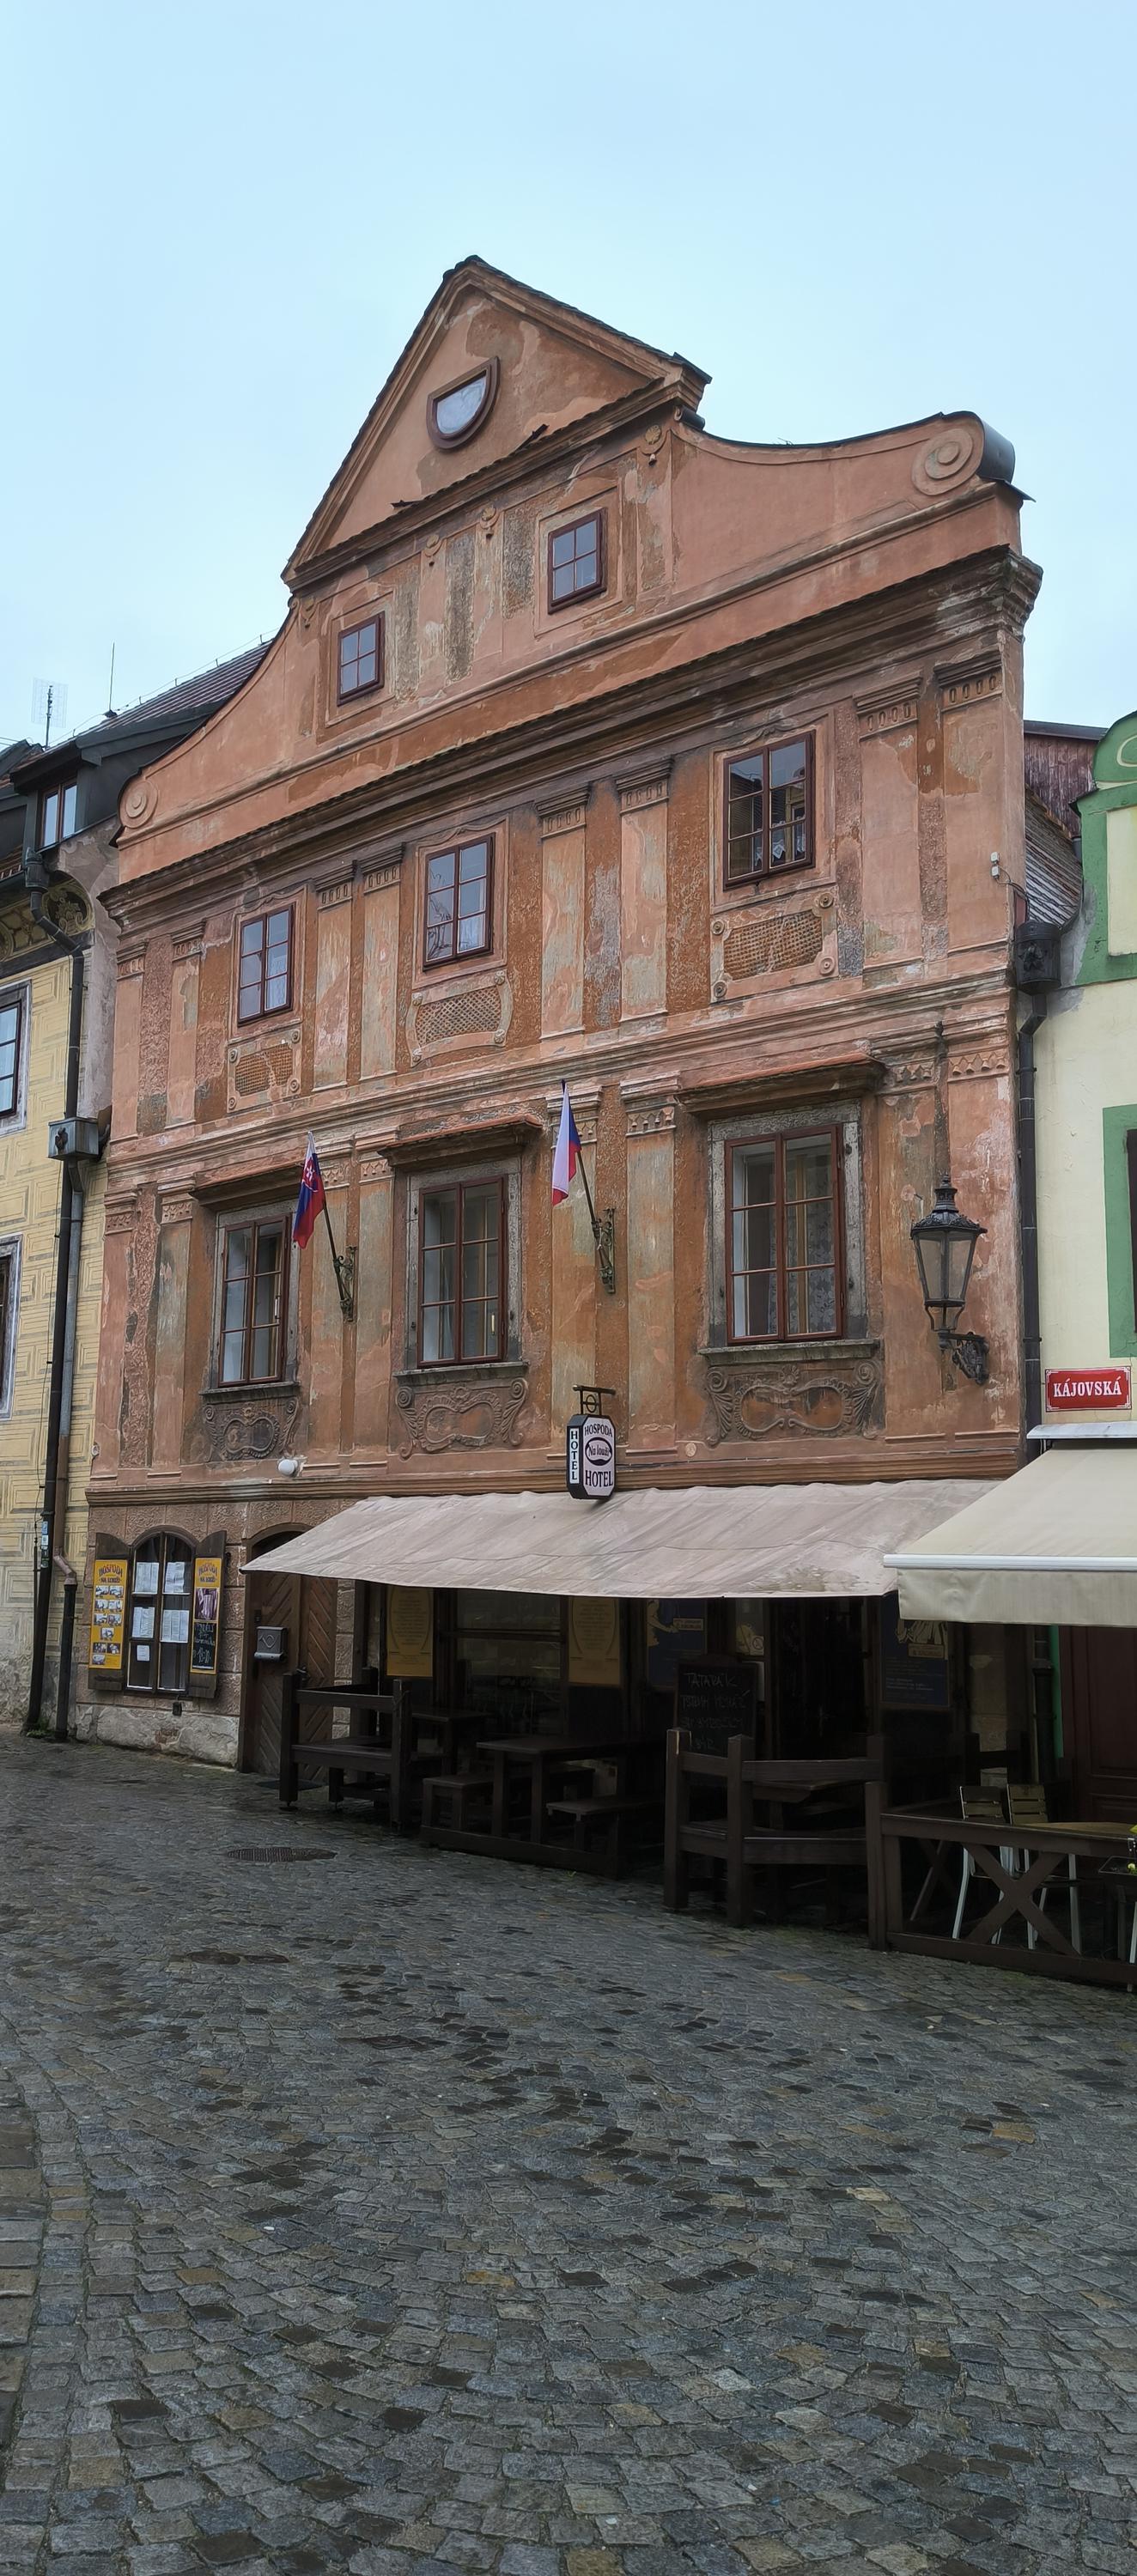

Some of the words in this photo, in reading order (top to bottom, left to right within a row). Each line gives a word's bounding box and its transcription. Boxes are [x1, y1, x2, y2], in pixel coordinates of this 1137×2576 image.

[1054, 1376, 1122, 1397] KÁJOVSKÁ
[585, 1424, 612, 1437] HOSPODA
[588, 1445, 596, 1457] Na
[585, 1470, 613, 1487] HOTEL
[99, 1564, 123, 1578] HOSPODA
